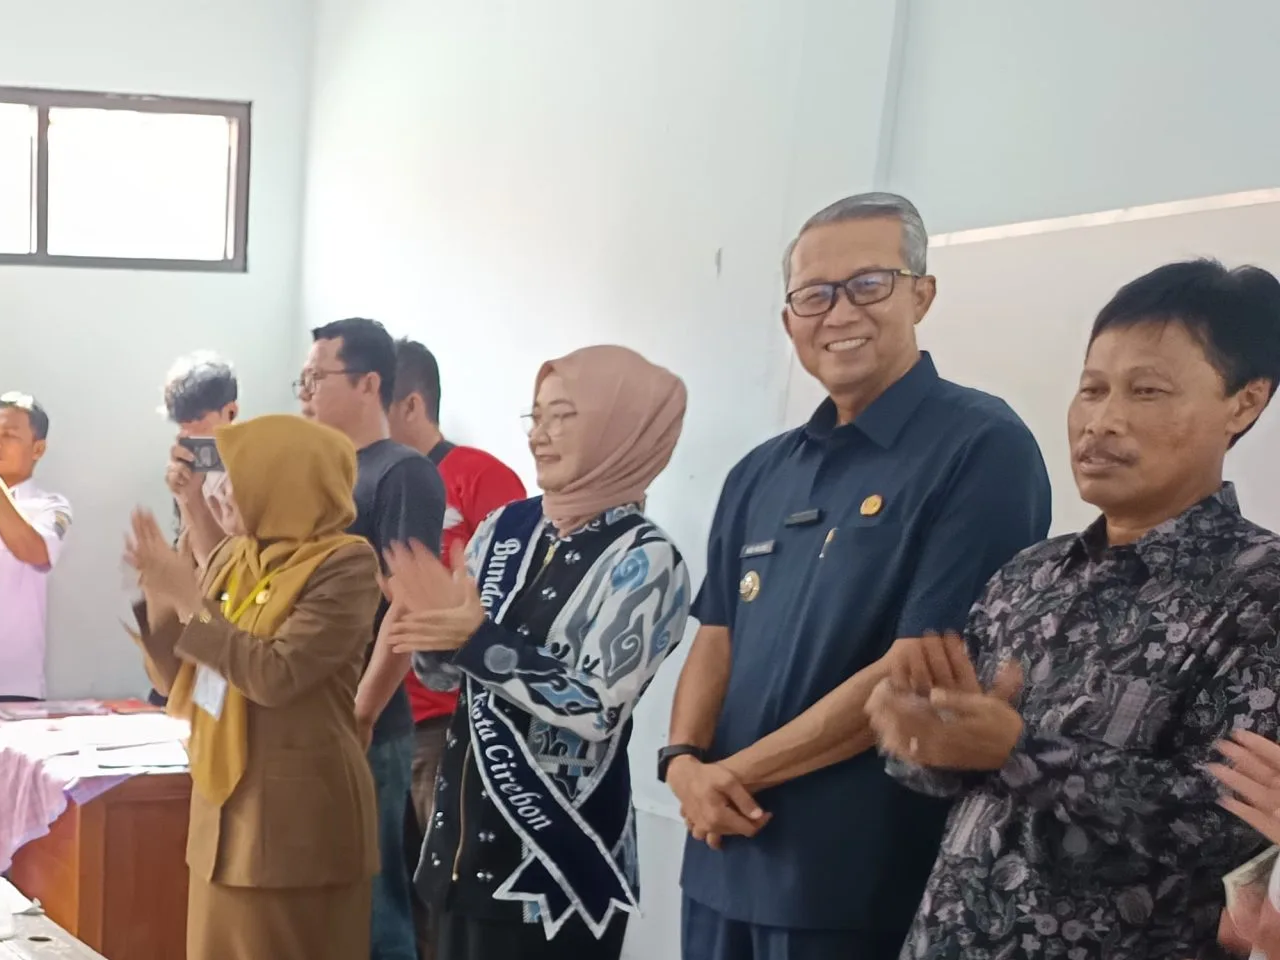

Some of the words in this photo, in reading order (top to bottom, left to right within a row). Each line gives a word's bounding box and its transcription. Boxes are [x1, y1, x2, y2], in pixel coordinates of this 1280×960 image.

[480, 538, 521, 609] Bunda
[471, 687, 498, 742] Kota
[485, 744, 553, 831] Cirebon
